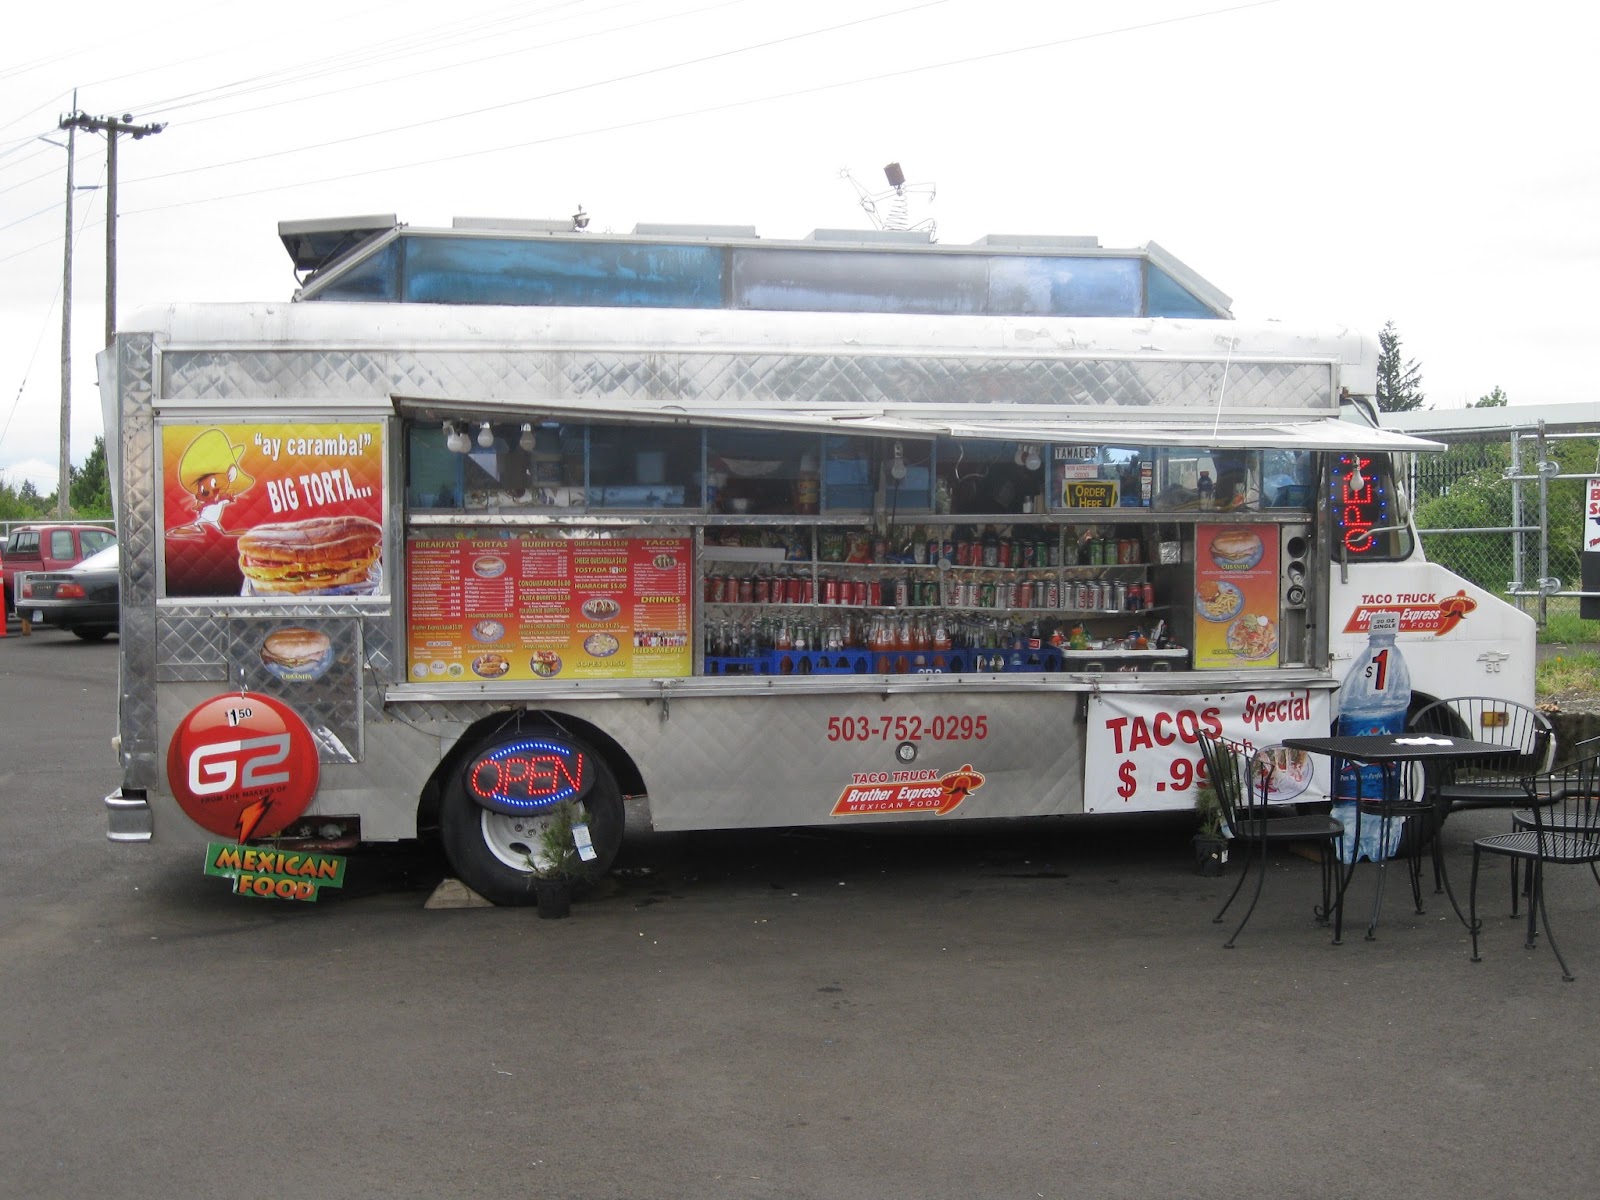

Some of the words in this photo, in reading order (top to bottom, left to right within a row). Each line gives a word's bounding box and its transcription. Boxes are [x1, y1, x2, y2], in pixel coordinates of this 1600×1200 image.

[1055, 447, 1096, 459] TAMALES
[266, 477, 299, 513] BIG
[1361, 594, 1392, 604] TACO
[1396, 593, 1436, 604] TRUCK
[1400, 608, 1441, 622] Express
[1242, 688, 1311, 732] Special
[827, 715, 988, 742] 503-752-0295
[1105, 706, 1223, 754] TACOS
[188, 732, 291, 796] G2
[471, 753, 584, 797] OPEN
[851, 772, 888, 784] TACO
[892, 769, 939, 782] TRUCK
[201, 795, 223, 804] FROM
[242, 789, 274, 798] MAKERS
[846, 788, 893, 803] Brother
[897, 786, 943, 802] Express
[850, 802, 903, 811] MEXICAN
[909, 800, 941, 808] FOOD
[215, 847, 339, 879] MEXICAN
[238, 874, 317, 900] FOOD
